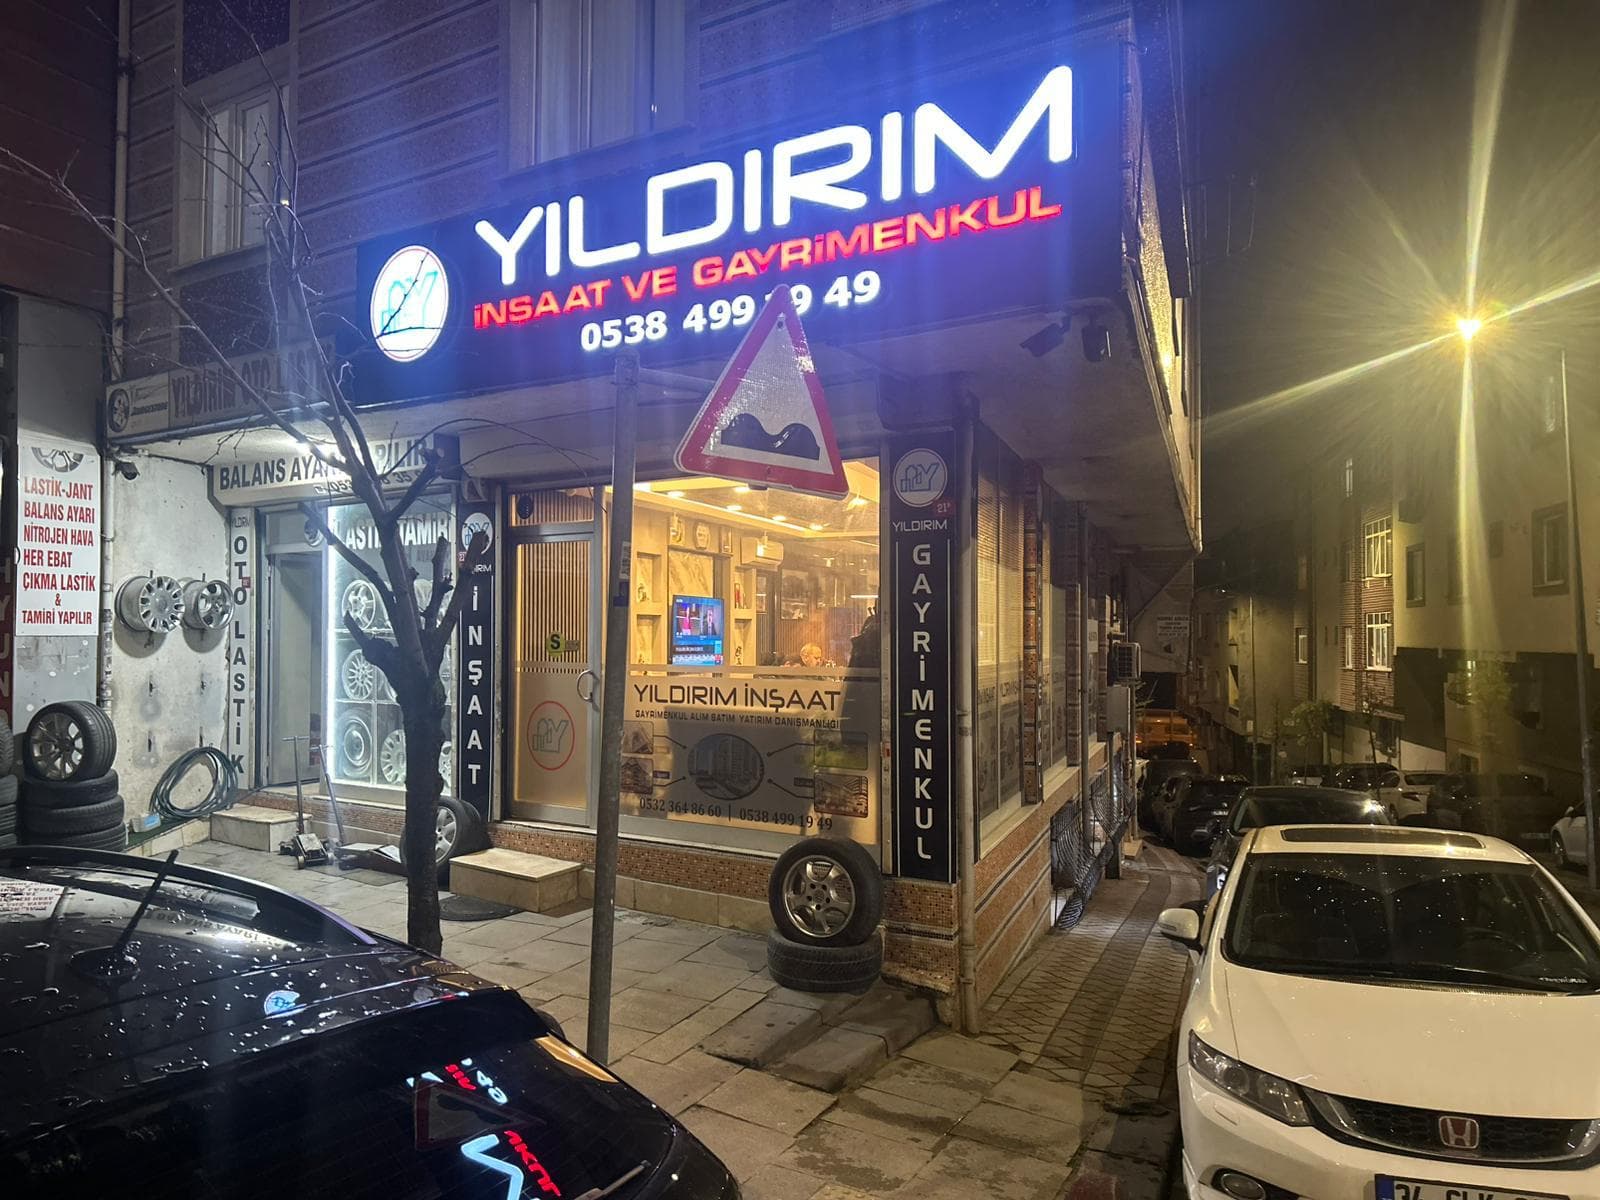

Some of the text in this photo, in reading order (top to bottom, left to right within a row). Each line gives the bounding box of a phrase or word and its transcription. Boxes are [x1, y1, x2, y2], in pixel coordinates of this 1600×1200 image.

[475, 65, 1074, 285] YILDIRIM
[621, 266, 678, 301] VE
[580, 269, 881, 352] 0538 499 9 49
[219, 457, 286, 490] BALANS
[289, 454, 340, 481] AYA
[24, 476, 94, 501] LASTİK-JANT
[24, 501, 95, 524] BALANS AYARI
[893, 519, 947, 532] YILDIRIM
[23, 522, 94, 546] NİTROJEN HAVA
[23, 549, 73, 568] HER EBAT
[233, 534, 248, 606] OTO
[23, 571, 96, 592] ÇIKMA LASTİK
[54, 593, 62, 607] &
[21, 607, 92, 625] TAMİRİ YAPILIR
[231, 619, 247, 774] LASTİK
[467, 585, 483, 785] İNŞAAT
[634, 682, 841, 713] YILDIRIM İNŞAAT
[912, 543, 935, 860] GAYRİMENKUL
[690, 711, 709, 721] ALIM
[711, 713, 735, 722] SATIM
[739, 714, 772, 725] YATIRIM
[639, 798, 833, 831] 0532 364 86 60 0538 499 19 49
